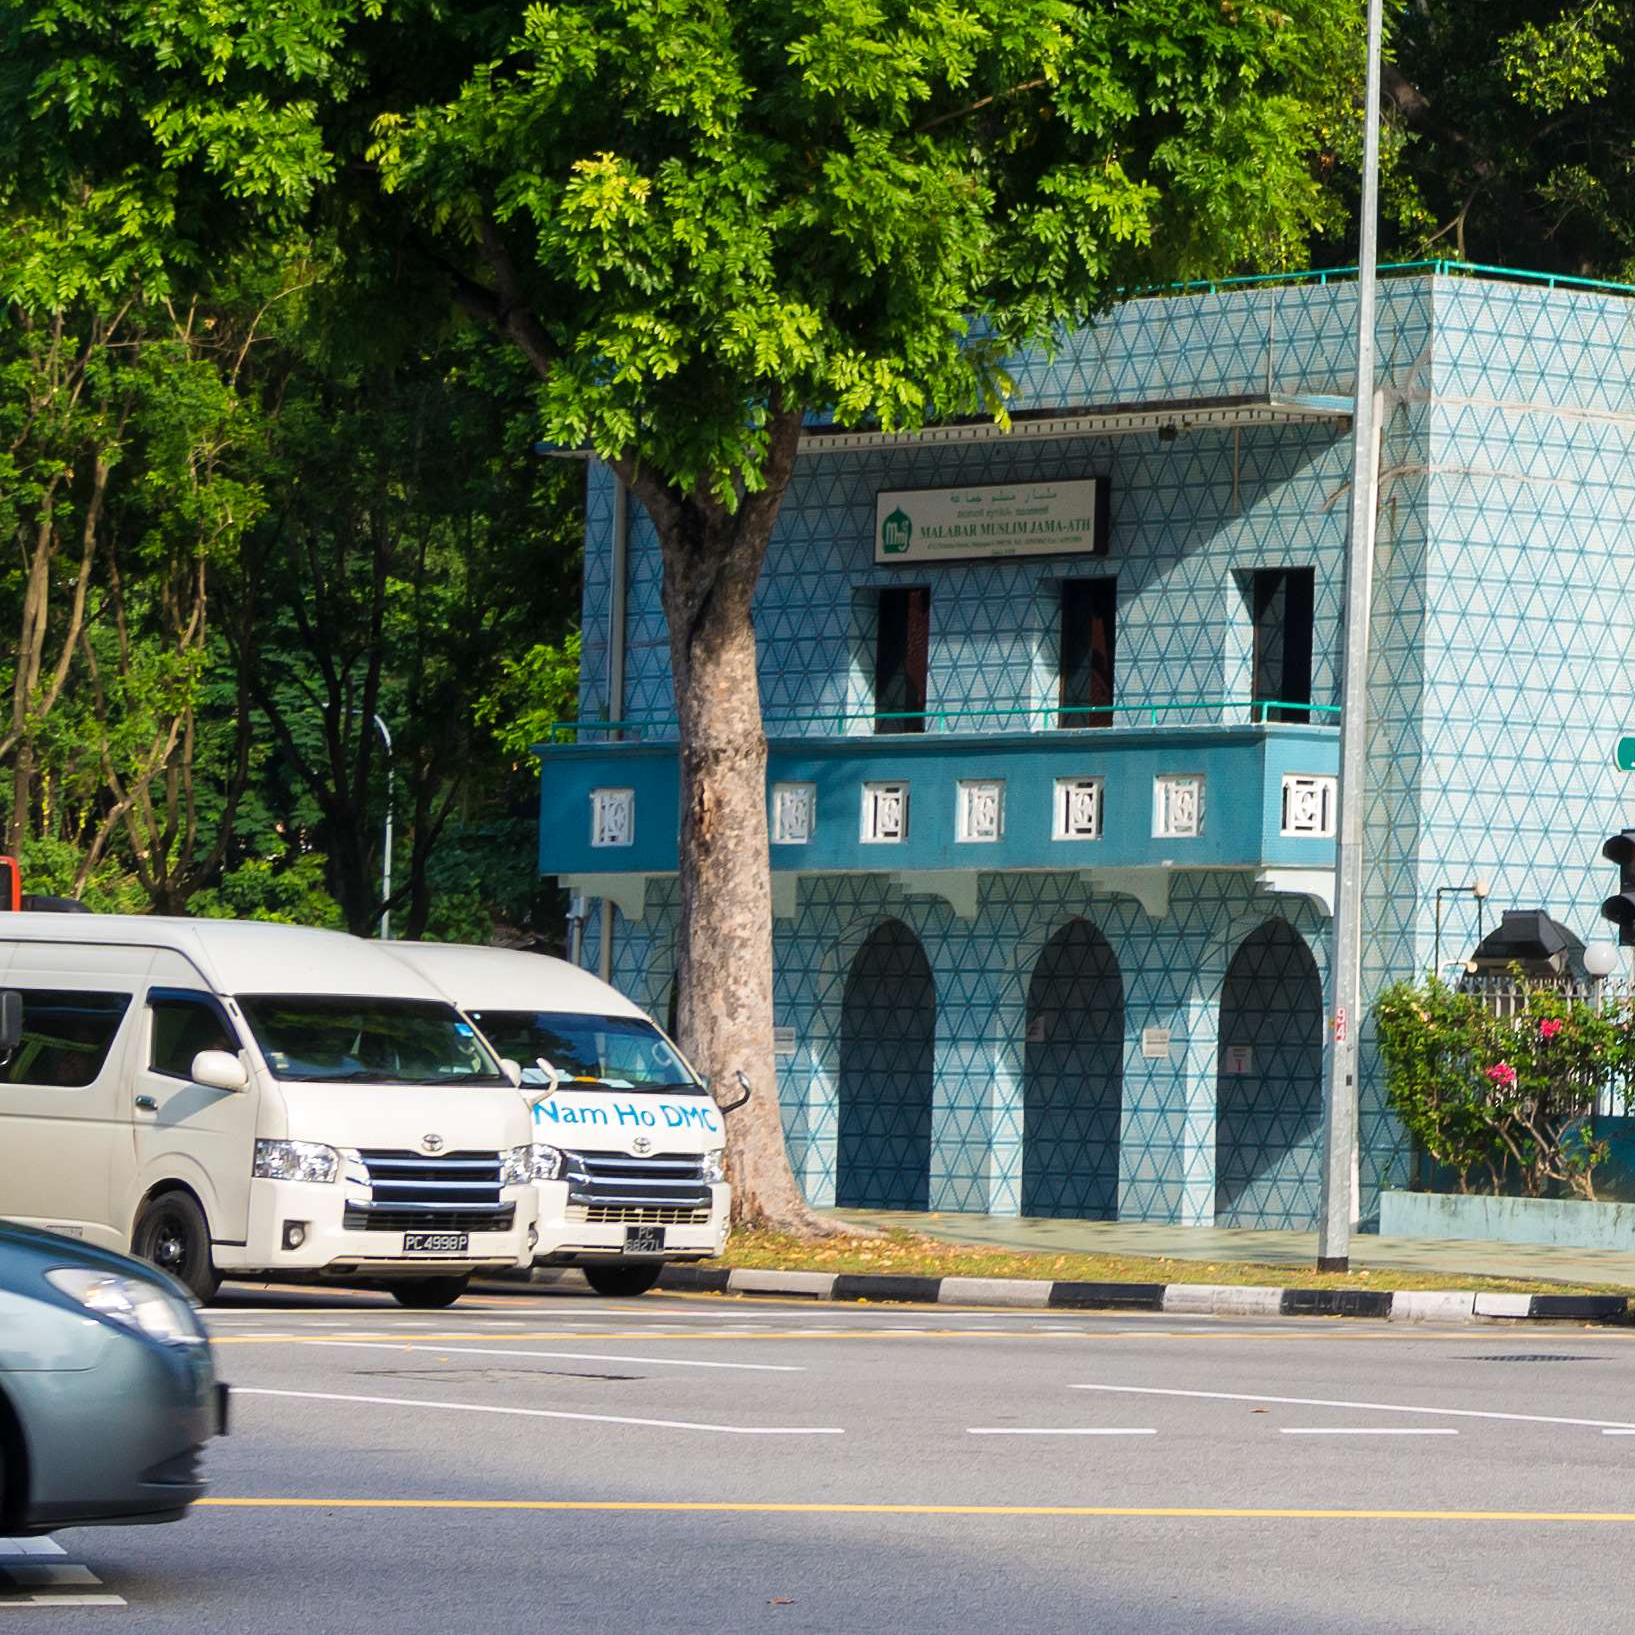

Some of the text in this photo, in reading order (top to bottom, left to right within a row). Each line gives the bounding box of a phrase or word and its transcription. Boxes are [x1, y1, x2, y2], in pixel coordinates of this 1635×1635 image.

[920, 525, 977, 539] MALABAR
[980, 522, 1027, 536] MUSLIM
[1030, 518, 1090, 533] JAMA-ATH
[533, 1101, 717, 1132] Nam Ho DMC
